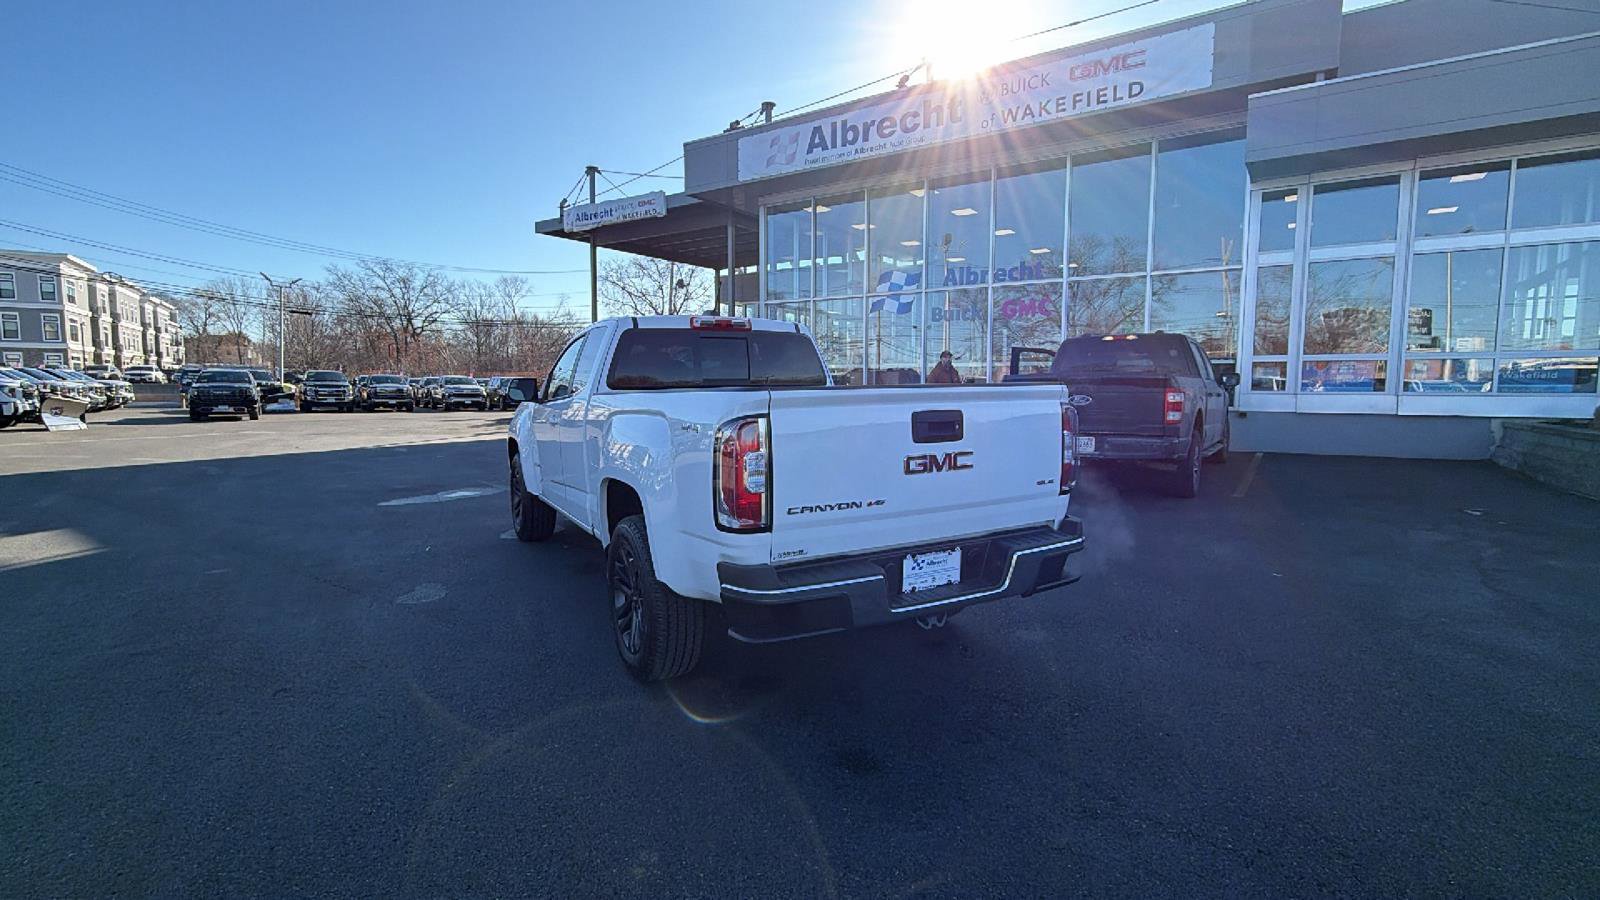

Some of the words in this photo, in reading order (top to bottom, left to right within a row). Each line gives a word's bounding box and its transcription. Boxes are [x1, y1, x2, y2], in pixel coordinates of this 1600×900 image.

[1001, 72, 1051, 97] BUICK
[1069, 49, 1147, 81] GMC
[981, 112, 997, 129] of
[1001, 81, 1145, 124] WAKEFIELD
[806, 92, 963, 155] Albrecht
[854, 143, 887, 156] Albrecht
[574, 206, 614, 222] Albrecht
[621, 208, 657, 220] WAKEFIELD
[943, 260, 1045, 287] Albrecht
[931, 305, 983, 322] Buick
[1001, 297, 1053, 320] GMC
[1501, 370, 1558, 379] Wakefield
[903, 451, 974, 475] GMC
[786, 501, 862, 515] CANYON
